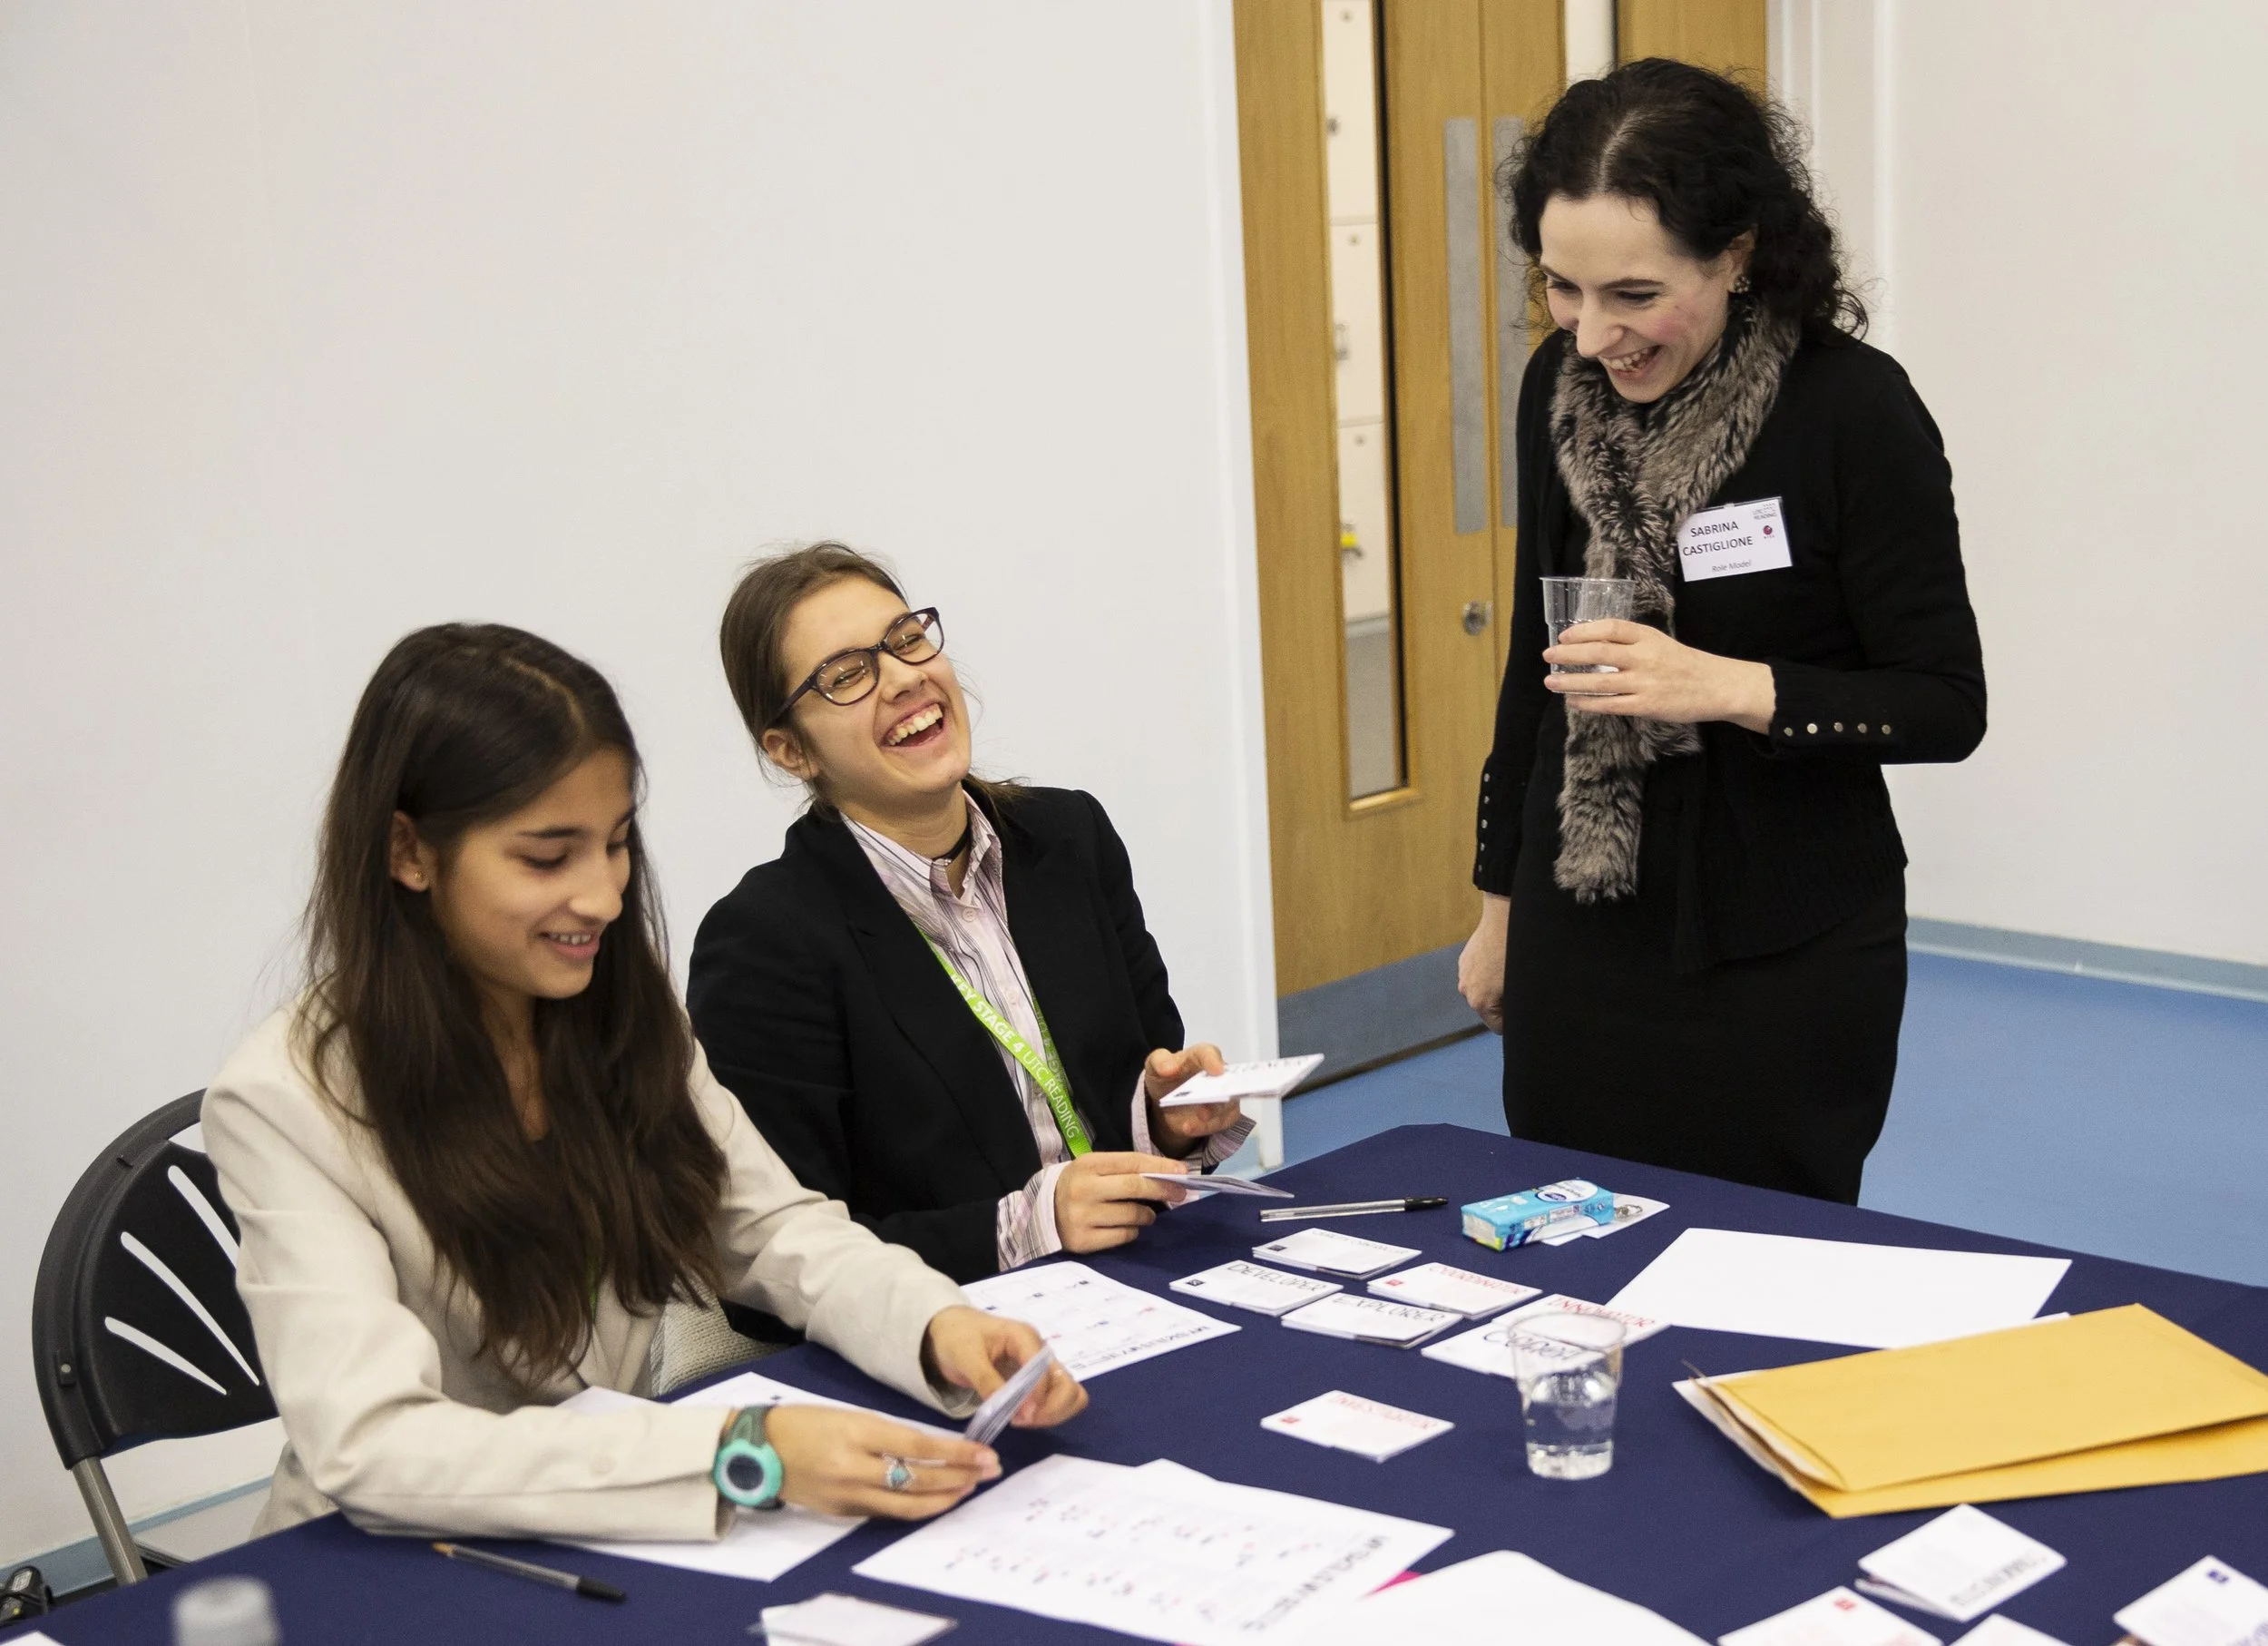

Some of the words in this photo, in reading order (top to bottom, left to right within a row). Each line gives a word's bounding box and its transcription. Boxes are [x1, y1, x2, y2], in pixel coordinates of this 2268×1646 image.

[1690, 521, 1739, 537] SABRINA
[1683, 536, 1753, 556] CASTIGLIONE
[1712, 564, 1728, 573] Role
[1728, 560, 1752, 571] Model
[973, 1001, 1016, 1043] STAGE
[1012, 1042, 1025, 1053] 4
[1022, 1051, 1050, 1081] UTC
[1044, 1077, 1080, 1139] READING
[1227, 1263, 1327, 1291] DEVELOPER
[1332, 1295, 1446, 1321] EXPLORER
